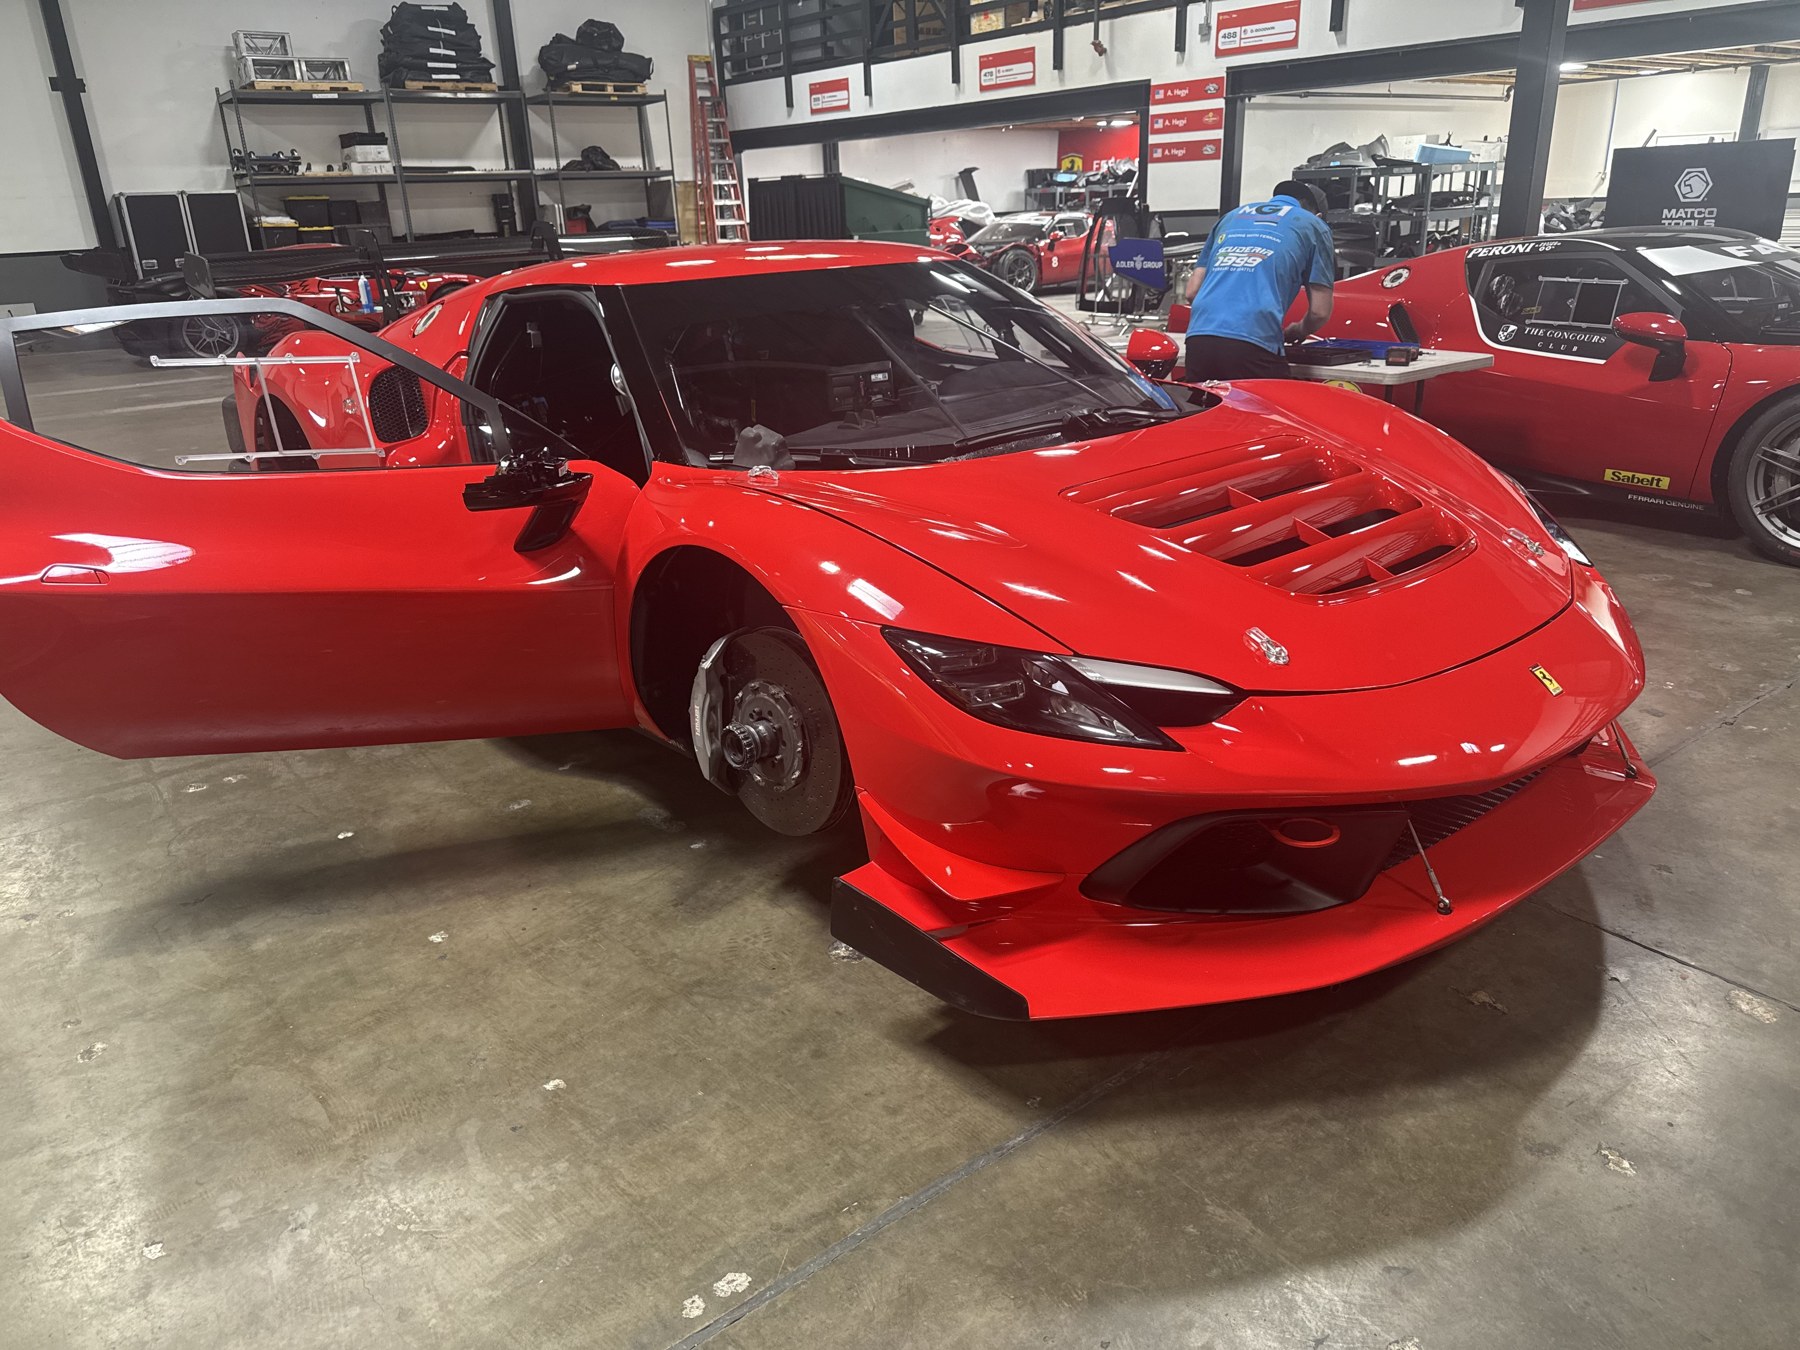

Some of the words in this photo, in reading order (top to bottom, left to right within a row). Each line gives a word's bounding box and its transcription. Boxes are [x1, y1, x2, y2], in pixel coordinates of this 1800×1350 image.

[1662, 208, 1717, 219] MATCO
[1216, 246, 1274, 256] SCUDERIA
[1467, 243, 1536, 258] PERONI
[1051, 256, 1059, 267] 8
[1213, 256, 1262, 267] 1999
[1524, 327, 1544, 336] THE
[1546, 330, 1607, 344] CONCOURS
[1610, 470, 1662, 487] Sabelt
[1627, 494, 1664, 504] FERRARI
[1665, 499, 1704, 511] GENUINE
